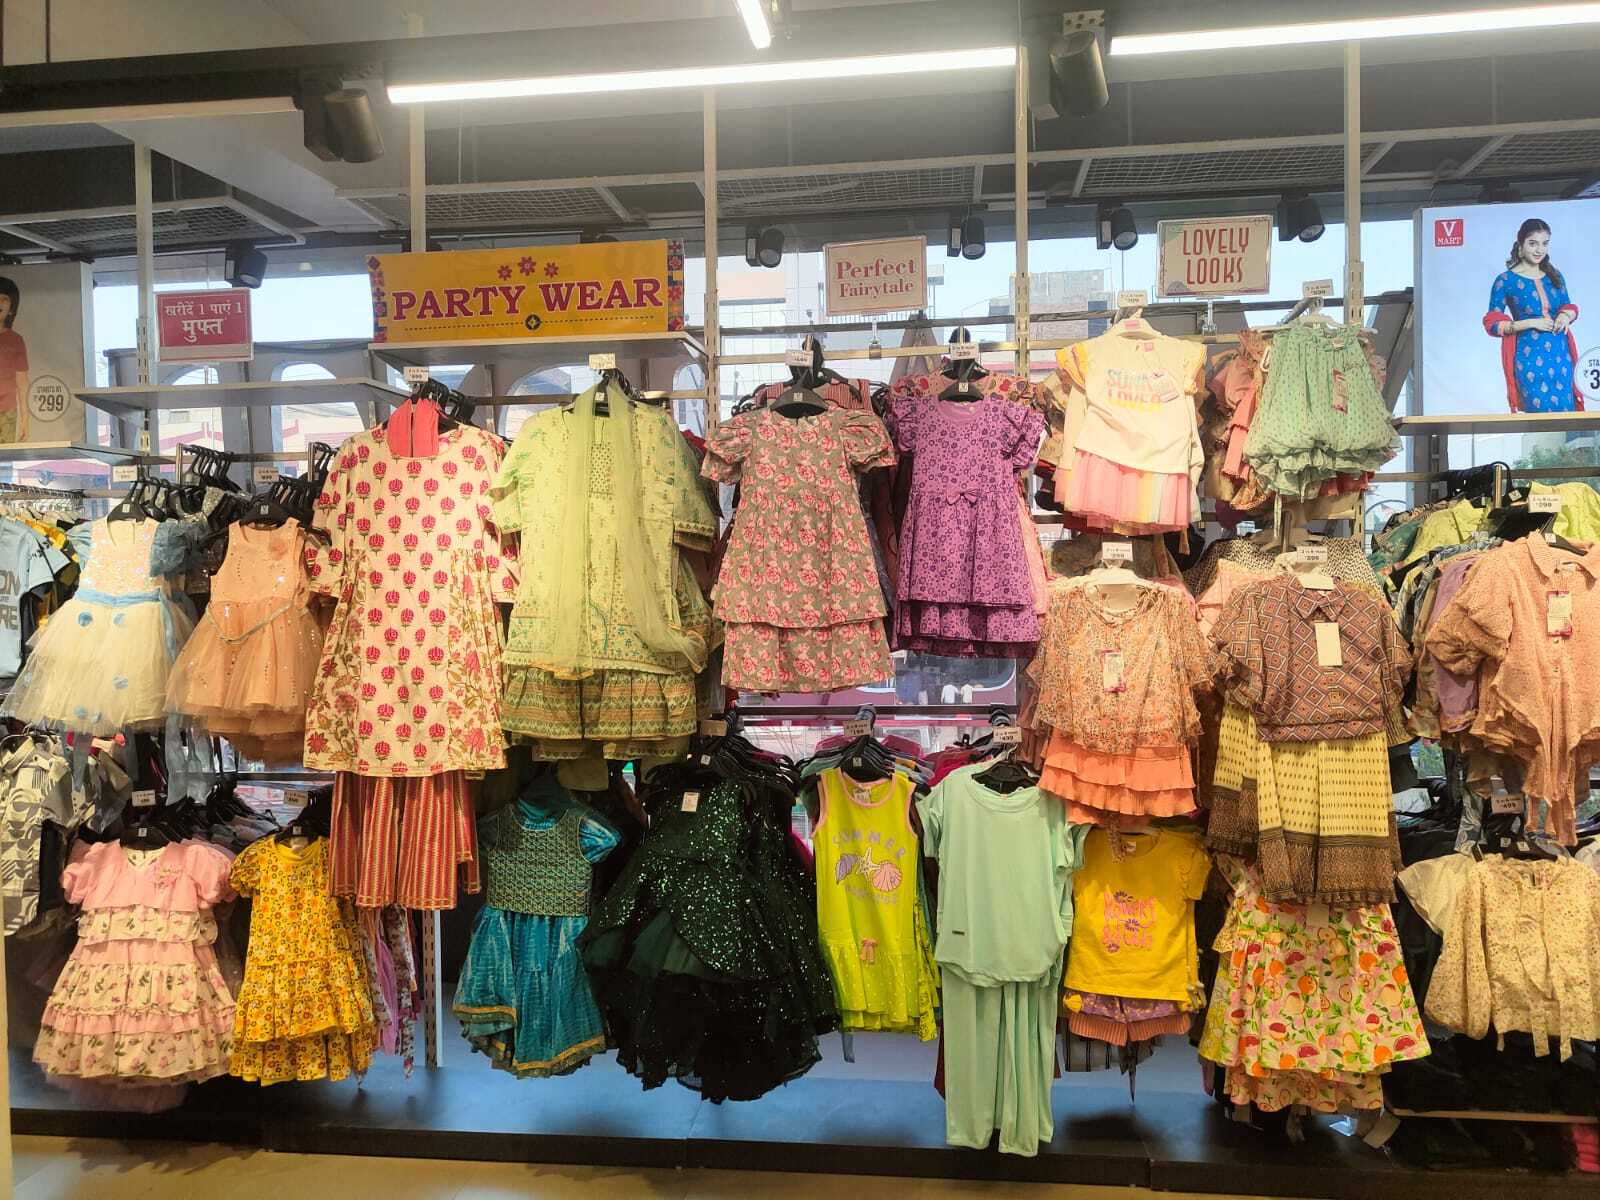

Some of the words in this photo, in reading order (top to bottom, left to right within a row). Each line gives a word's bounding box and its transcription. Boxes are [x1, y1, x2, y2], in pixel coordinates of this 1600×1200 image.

[1440, 220, 1456, 237] V
[1183, 227, 1250, 255] LOVELY
[1437, 237, 1462, 246] MART
[836, 258, 916, 280] Perfect
[1186, 256, 1242, 285] LOOKS
[839, 278, 914, 298] Fairytale
[164, 301, 194, 317] खरीदें
[392, 284, 526, 321] PARTY
[539, 278, 664, 313] WEAR
[181, 318, 224, 343] मुफ्त
